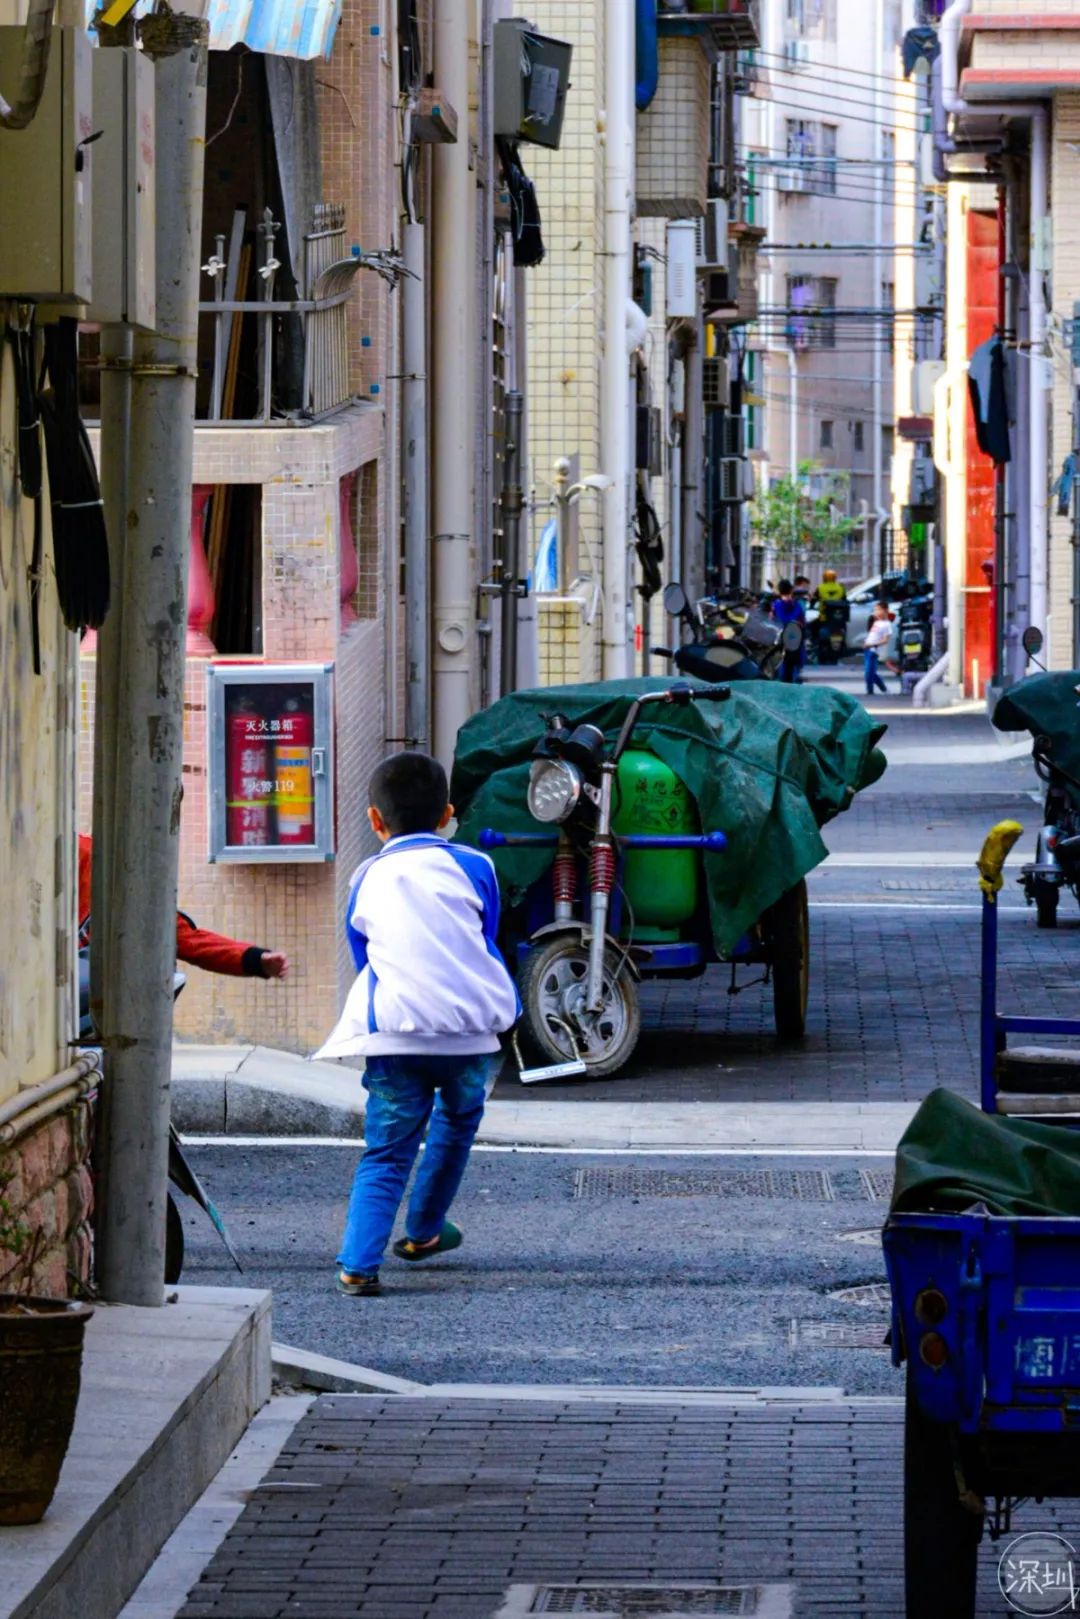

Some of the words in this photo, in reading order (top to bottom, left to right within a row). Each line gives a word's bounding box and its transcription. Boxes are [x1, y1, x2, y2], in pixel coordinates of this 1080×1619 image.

[246, 719, 294, 732] 灭火器箱
[248, 780, 295, 793] 火警119
